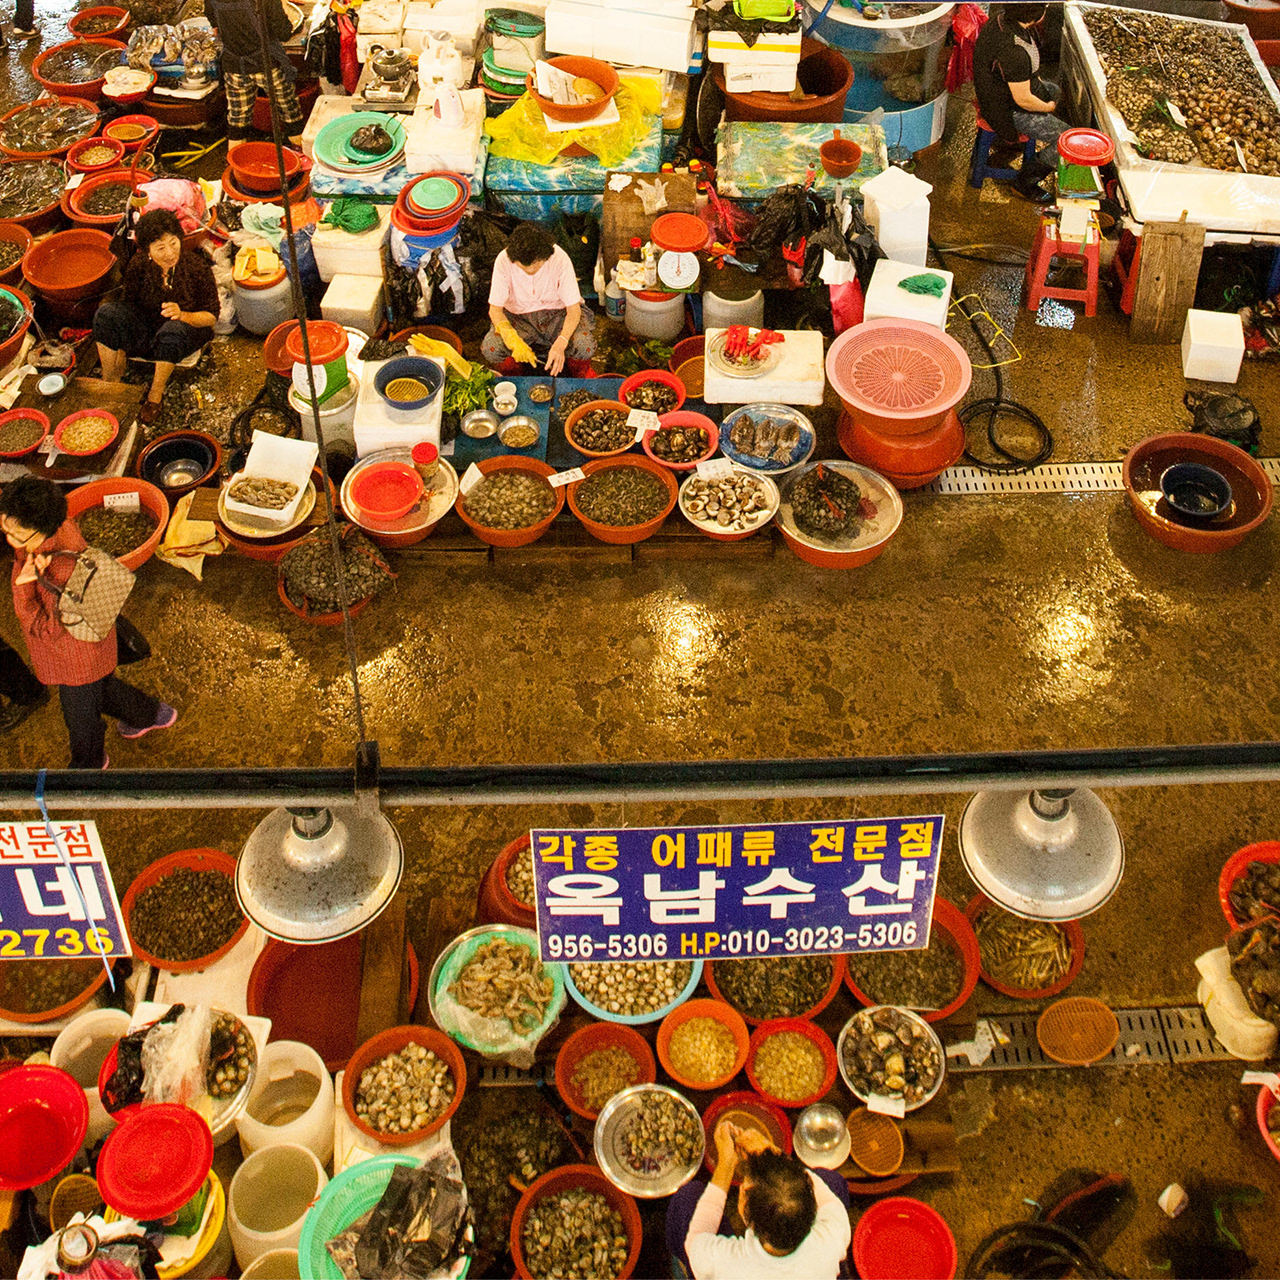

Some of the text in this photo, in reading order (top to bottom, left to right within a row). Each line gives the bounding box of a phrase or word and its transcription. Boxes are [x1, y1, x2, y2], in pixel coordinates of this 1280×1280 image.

[538, 821, 934, 872] 각종 어패류 전문점
[545, 860, 927, 926] 옥남수산
[547, 933, 669, 959] 956-5306
